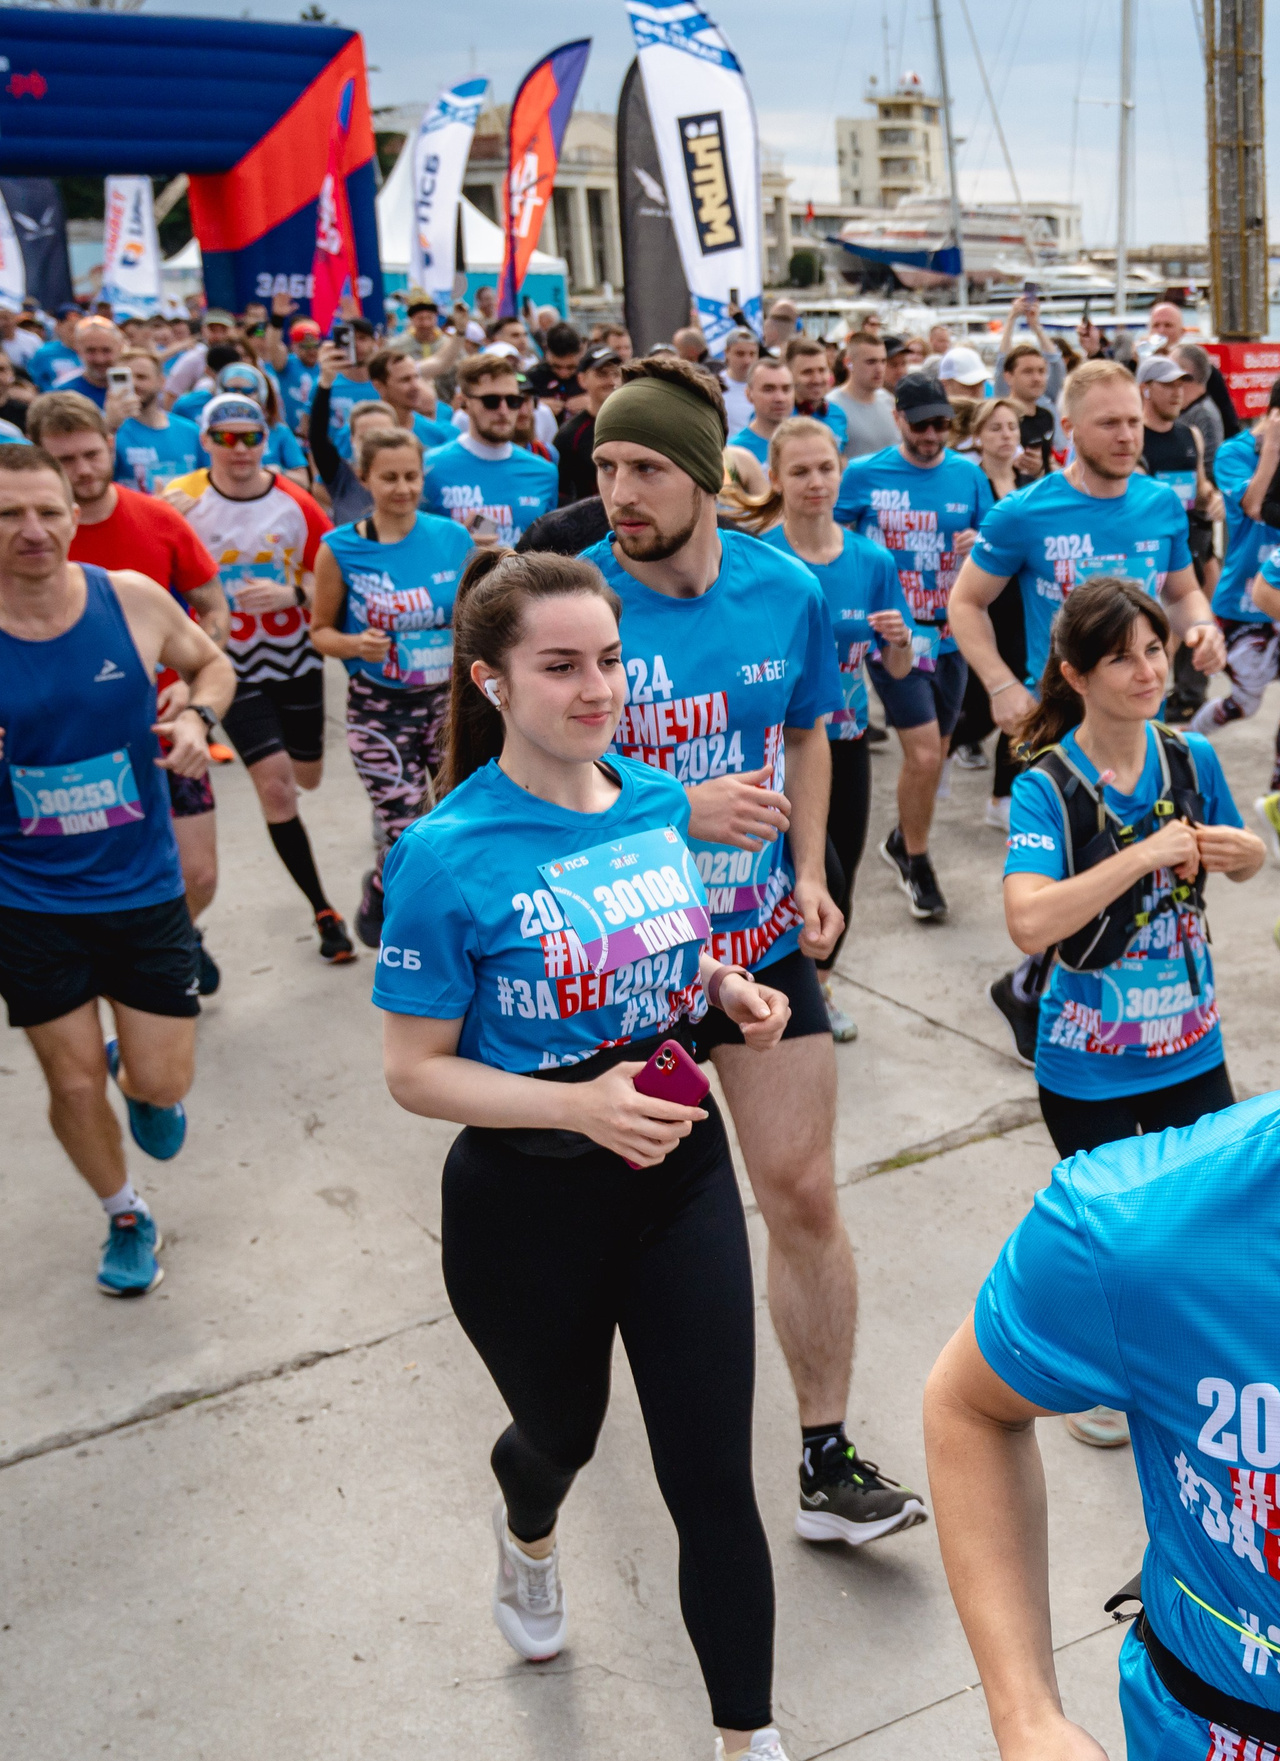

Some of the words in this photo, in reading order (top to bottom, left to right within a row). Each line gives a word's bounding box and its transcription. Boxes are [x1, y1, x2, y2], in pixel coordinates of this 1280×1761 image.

[441, 485, 484, 508] 2024
[871, 490, 911, 510] 2024
[878, 510, 938, 532] #МЕЧТА
[1044, 533, 1095, 560] 2024
[624, 654, 674, 702] 24
[614, 690, 729, 746] #МЕЧТА
[37, 779, 116, 815] 30253
[1013, 833, 1056, 851] ПСБ
[564, 855, 590, 872] ПСБ
[694, 850, 754, 886] 0210
[593, 865, 690, 925] 30108
[633, 909, 698, 954] 10КМ
[497, 948, 685, 1020] #ЗАБЕГ2024
[1140, 1014, 1184, 1045] 10КМ
